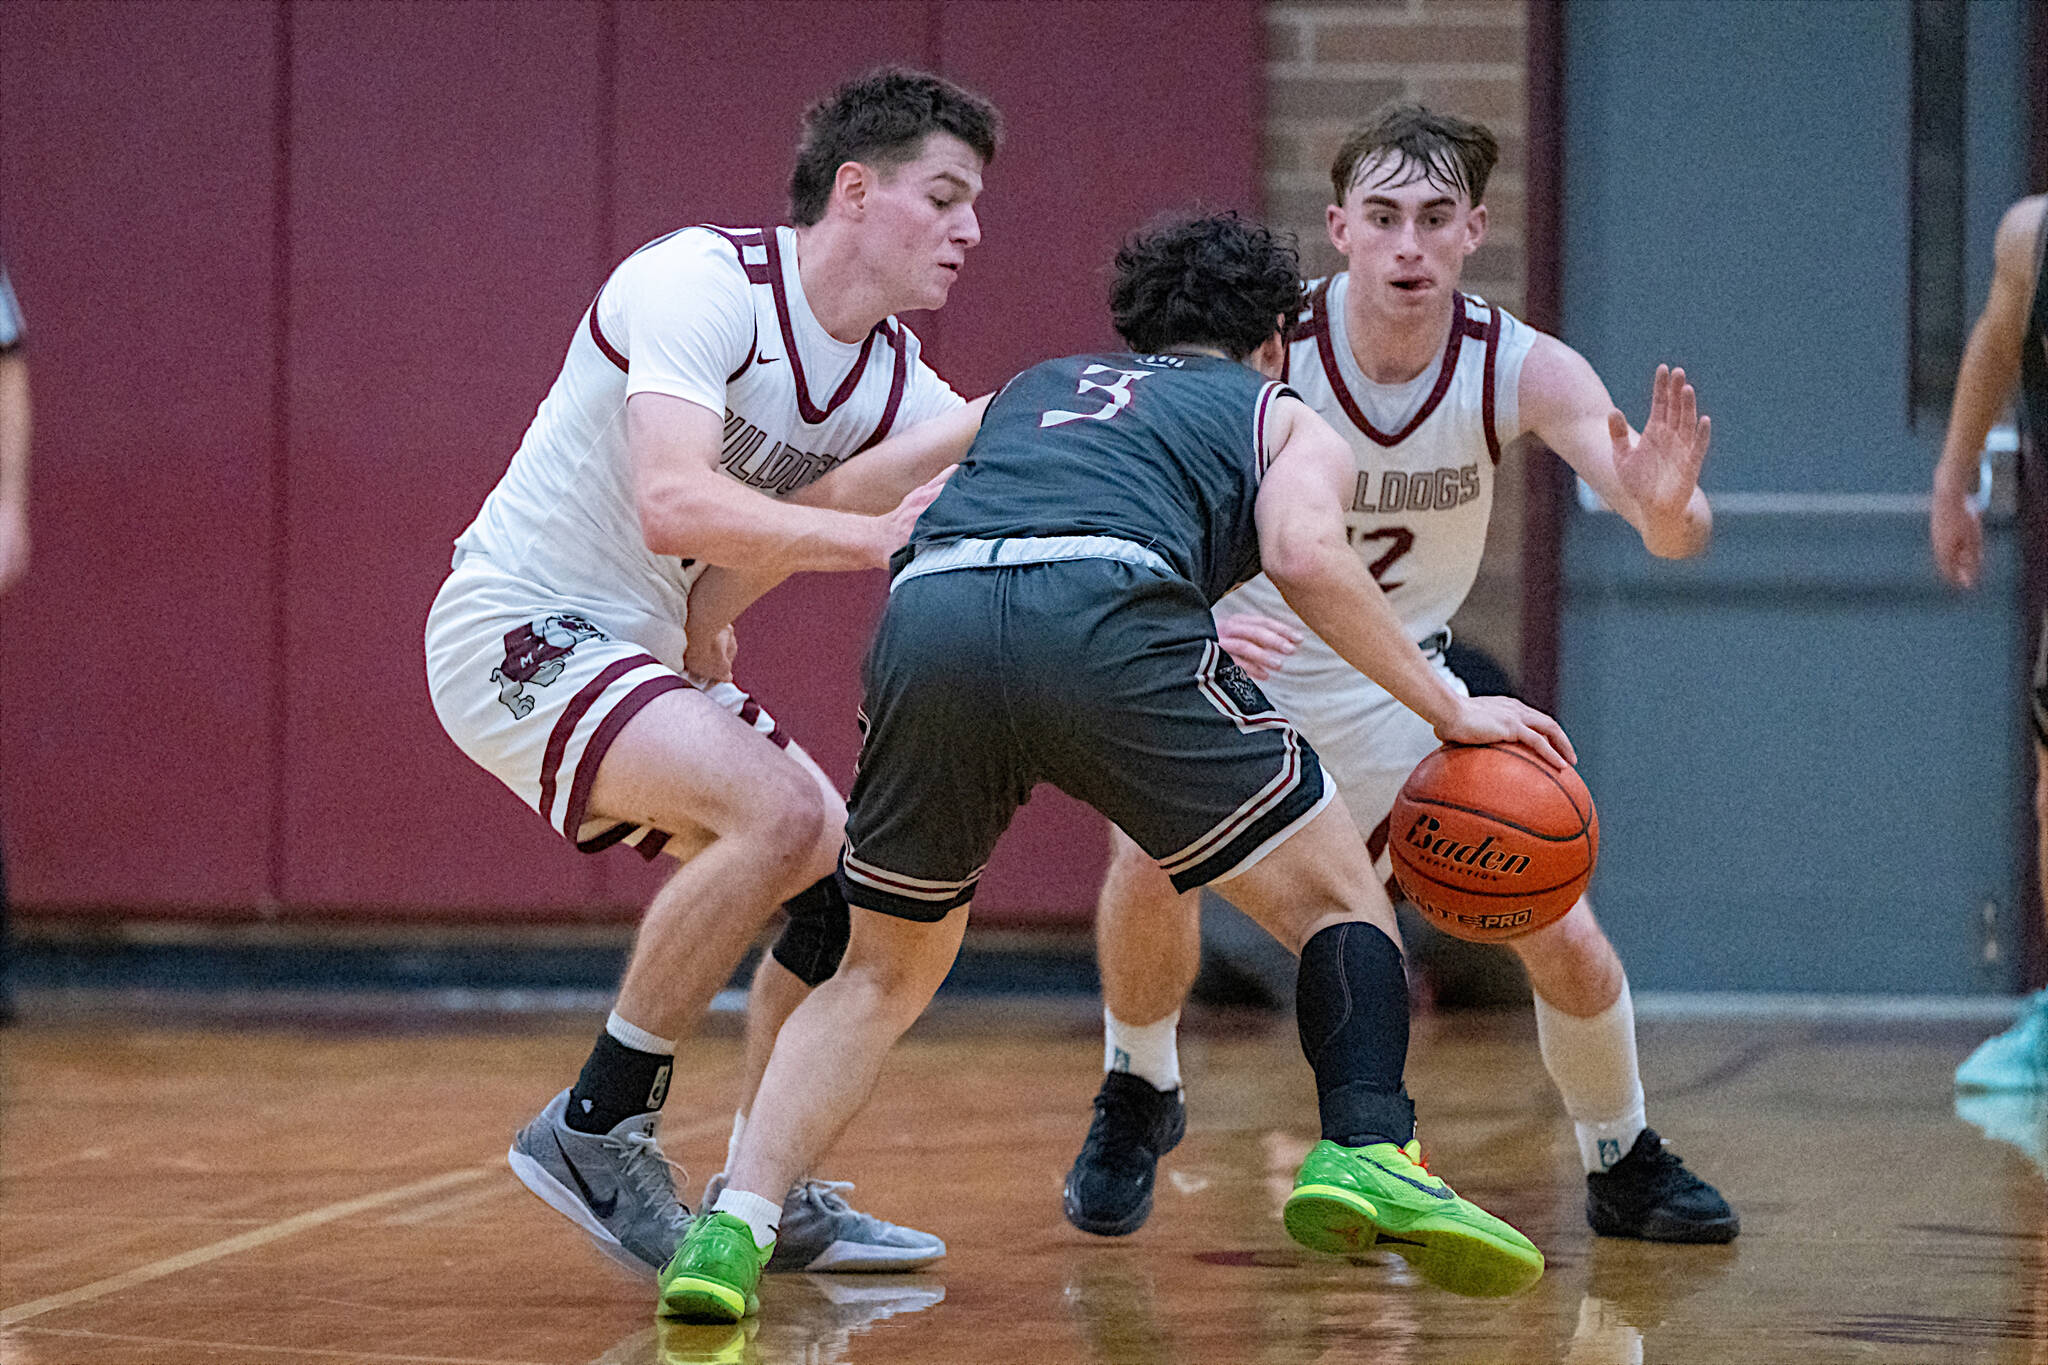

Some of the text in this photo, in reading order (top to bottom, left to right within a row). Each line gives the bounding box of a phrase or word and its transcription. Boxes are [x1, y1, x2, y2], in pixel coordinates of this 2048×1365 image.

[1040, 364, 1156, 428] 3
[1349, 464, 1480, 513] LDOGS
[1346, 525, 1415, 593] 2
[520, 652, 534, 669] M
[1405, 815, 1531, 875] Baden
[1484, 910, 1531, 929] PRO
